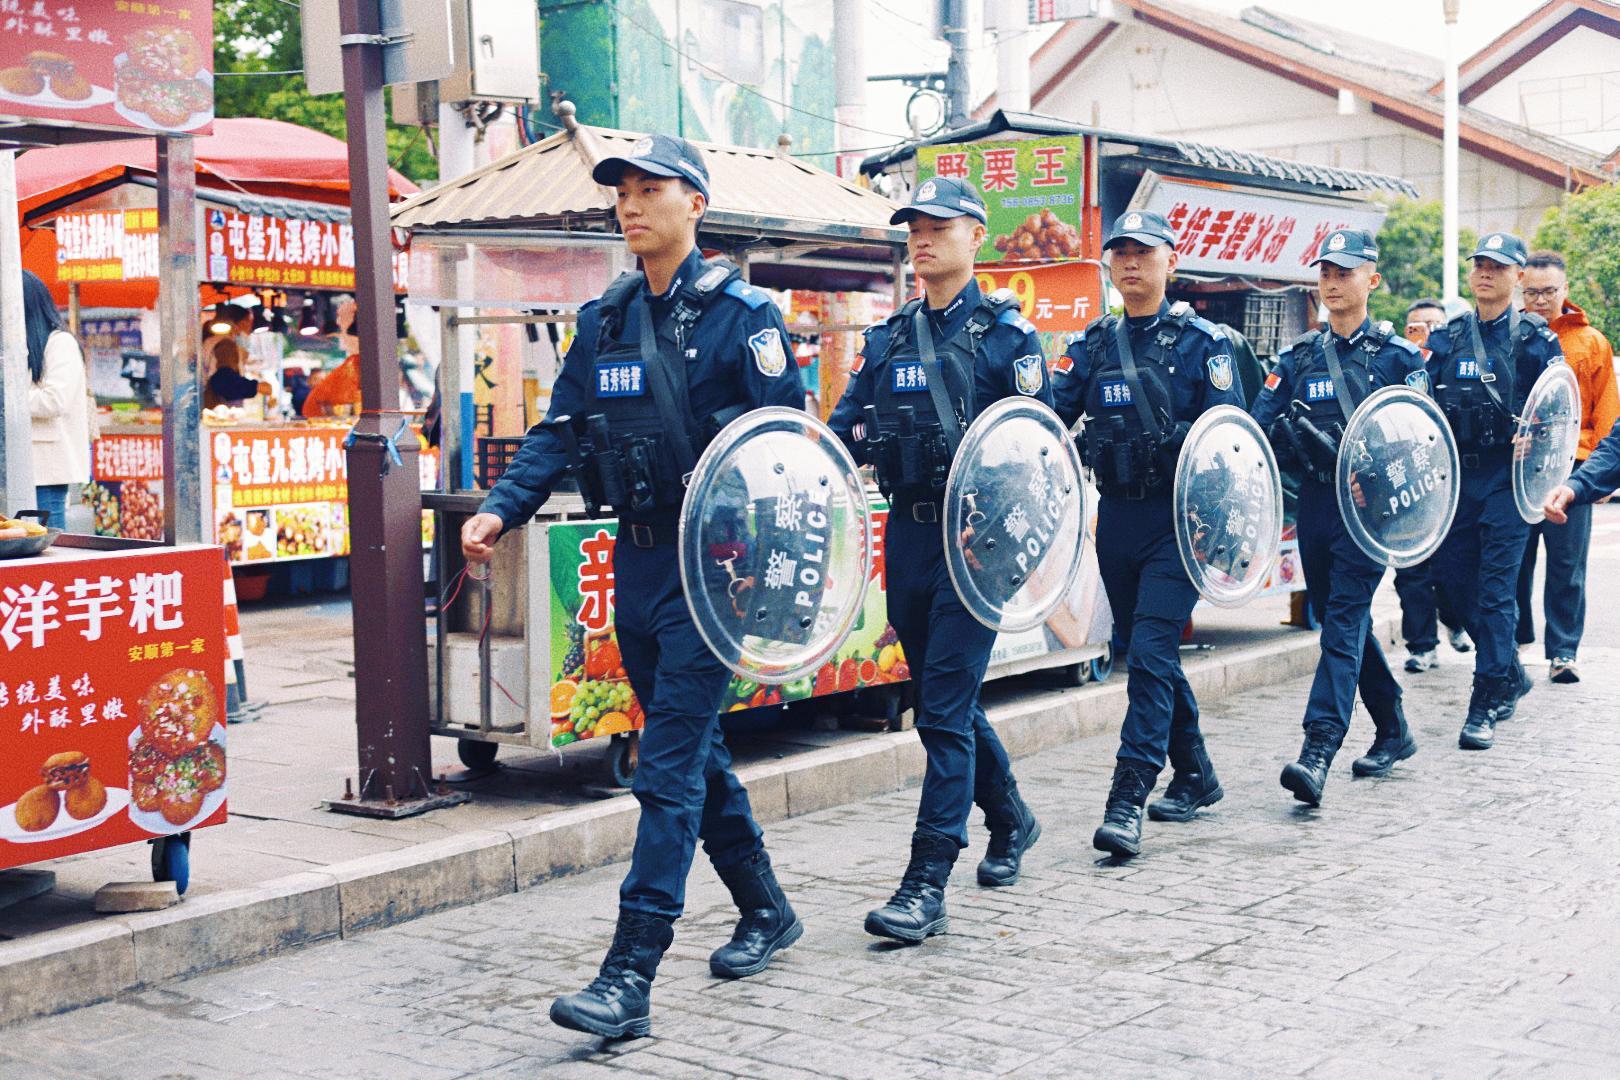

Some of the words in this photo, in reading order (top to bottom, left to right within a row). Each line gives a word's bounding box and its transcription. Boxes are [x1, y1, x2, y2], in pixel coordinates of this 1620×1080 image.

[1036, 296, 1091, 320] 元一斤
[599, 366, 642, 392] 西秀特警
[896, 365, 927, 388] 西秀特
[1103, 384, 1131, 403] 西秀特
[1309, 381, 1334, 399] 西秀特
[231, 435, 347, 485] 屯堡九溪烤小
[764, 492, 802, 590] 警察
[0, 570, 185, 651] 洋芋粑
[128, 637, 206, 663] 安顺第一家
[20, 697, 128, 735] 外酥里嫩
